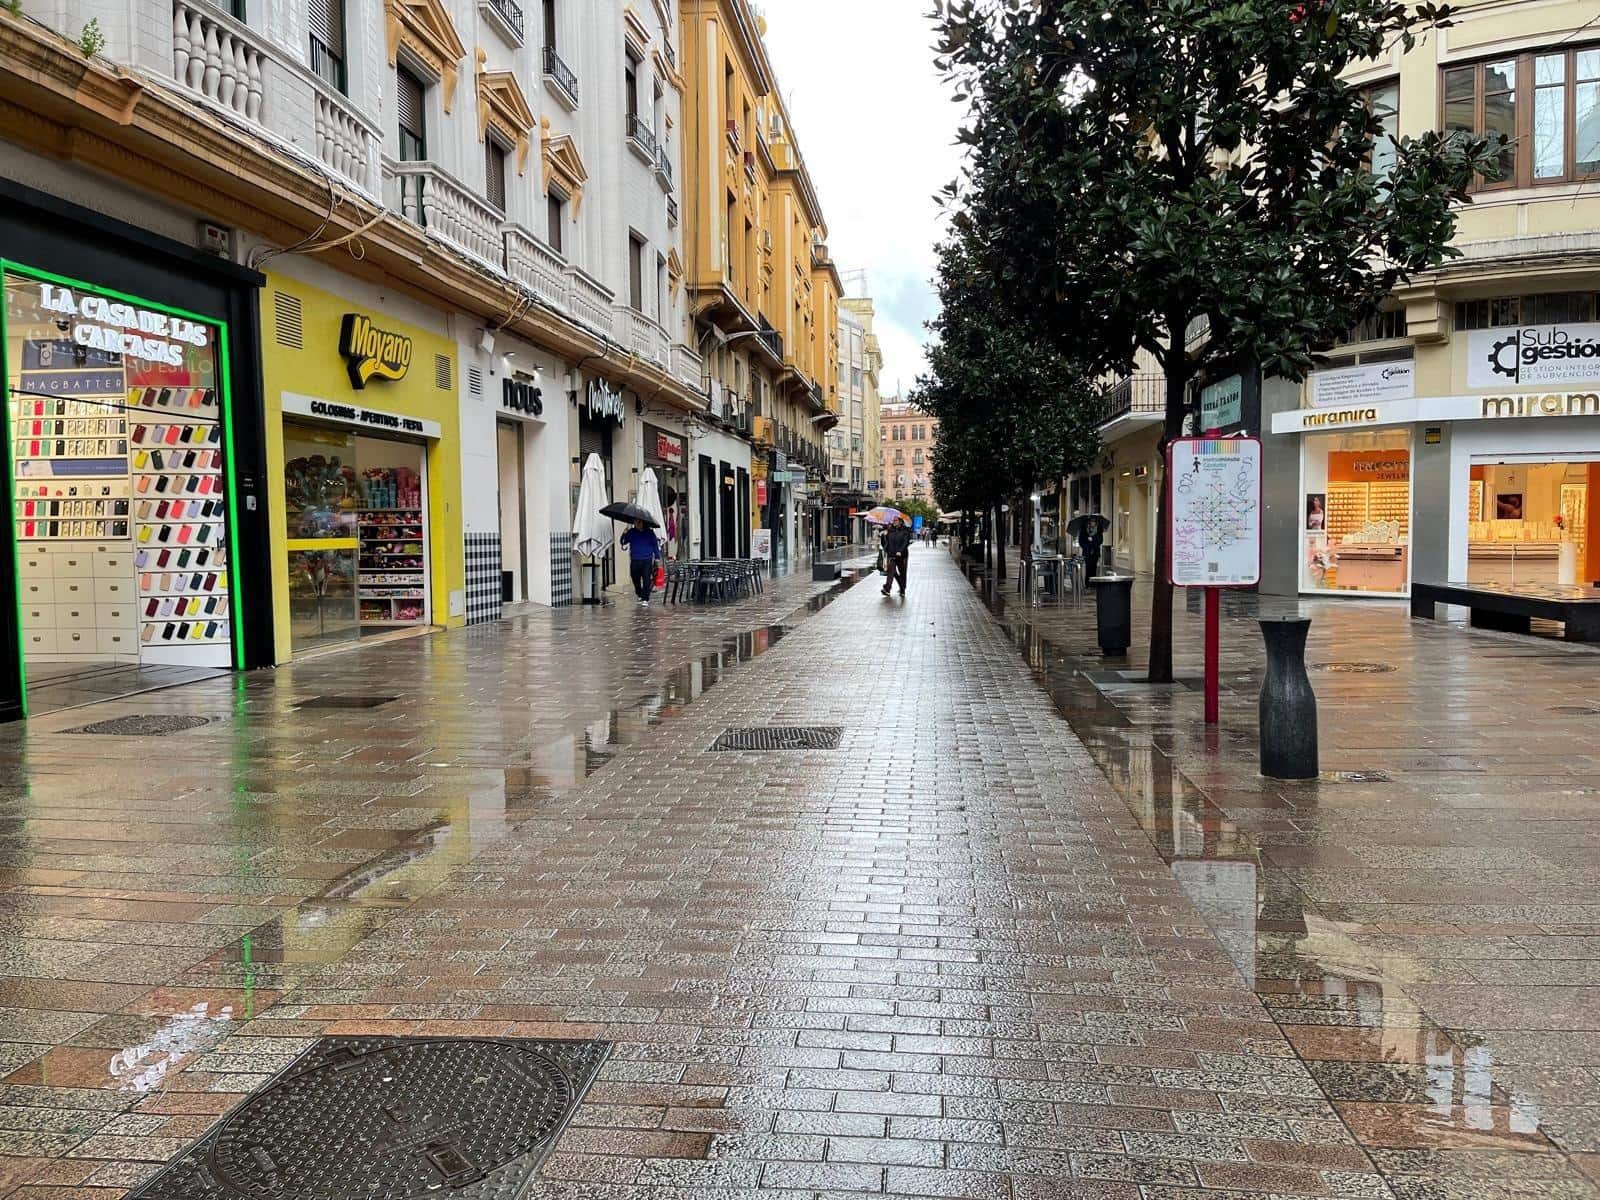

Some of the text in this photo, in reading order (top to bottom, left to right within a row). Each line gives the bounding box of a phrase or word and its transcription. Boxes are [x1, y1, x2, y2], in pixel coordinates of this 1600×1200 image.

[39, 283, 207, 347] LA CASA DE LAS
[74, 324, 183, 366] CARCASAS
[351, 316, 411, 369] Moyano
[1522, 326, 1568, 347] Sub
[1520, 365, 1561, 374] GESTIÓN
[26, 379, 122, 390] MAGBATTER
[1482, 394, 1600, 417] miram
[1303, 408, 1376, 426] miramira
